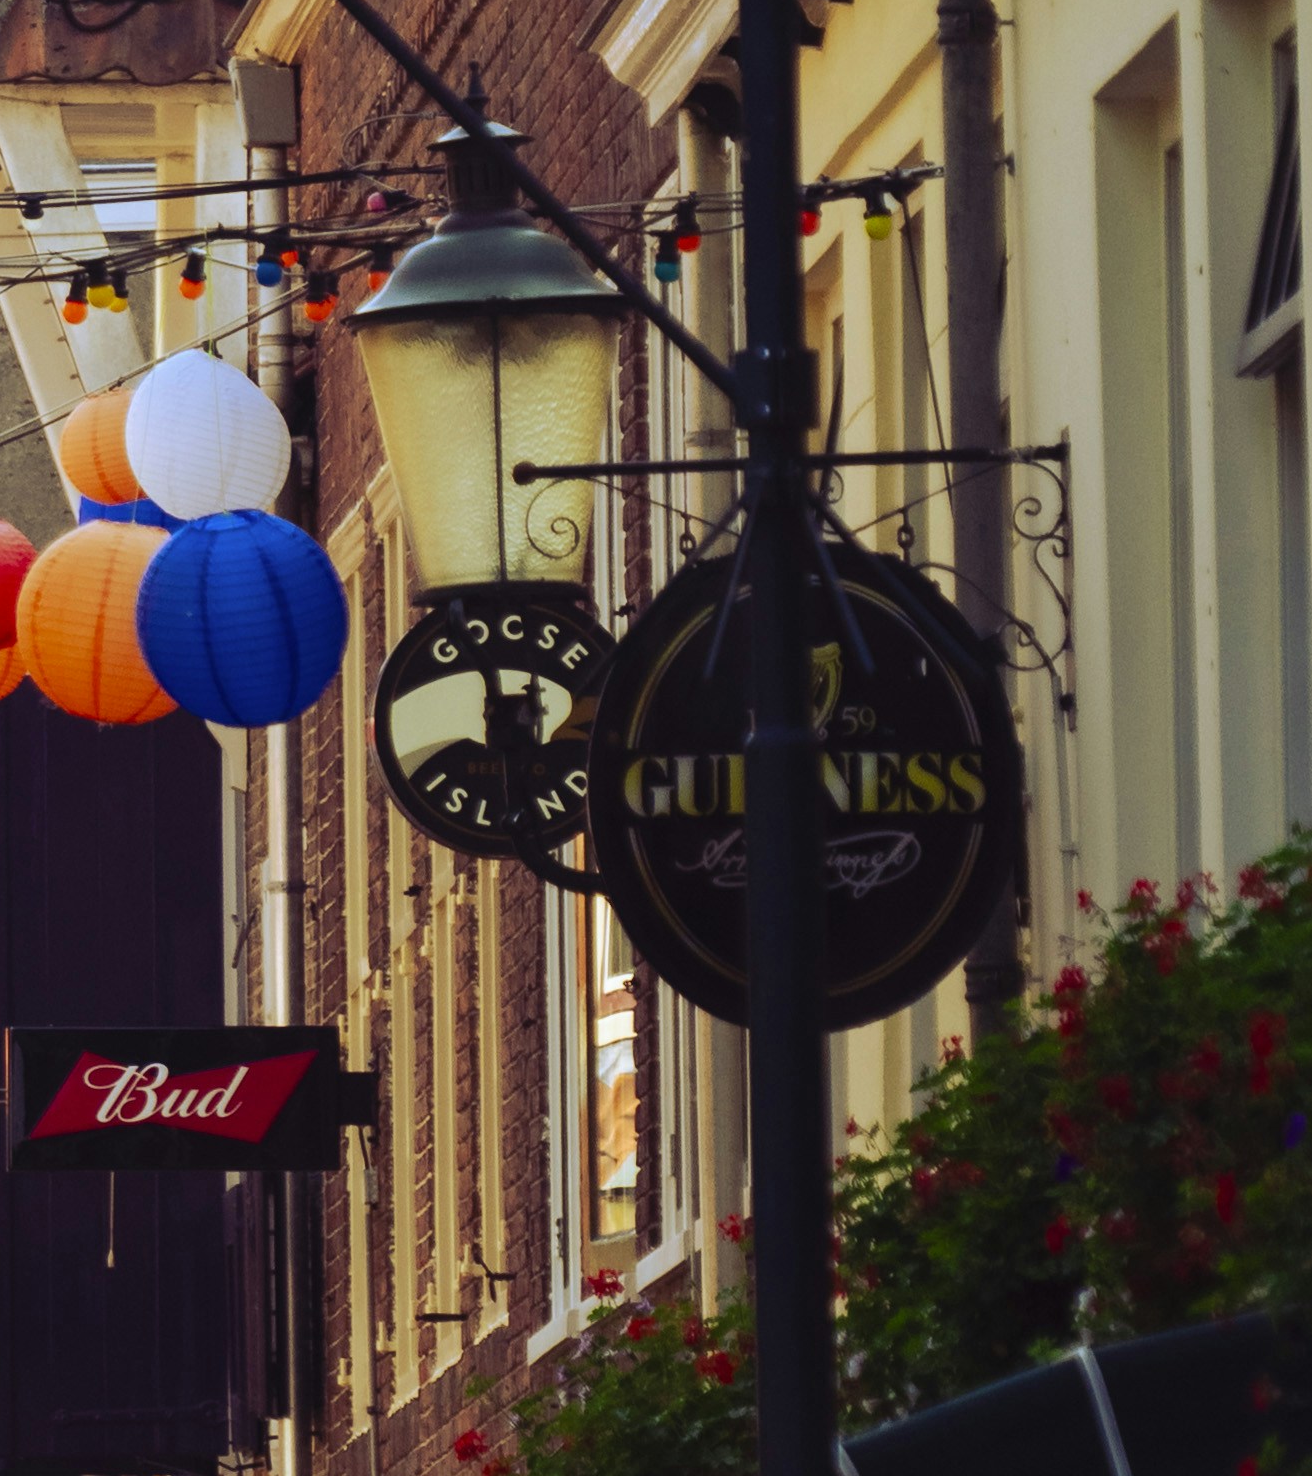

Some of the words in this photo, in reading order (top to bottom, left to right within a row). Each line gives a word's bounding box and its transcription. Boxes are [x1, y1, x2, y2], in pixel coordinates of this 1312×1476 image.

[432, 615, 589, 670] GOOSE
[426, 770, 588, 826] ISLND
[623, 752, 987, 817] GUINESS
[83, 1062, 250, 1123] Bud
